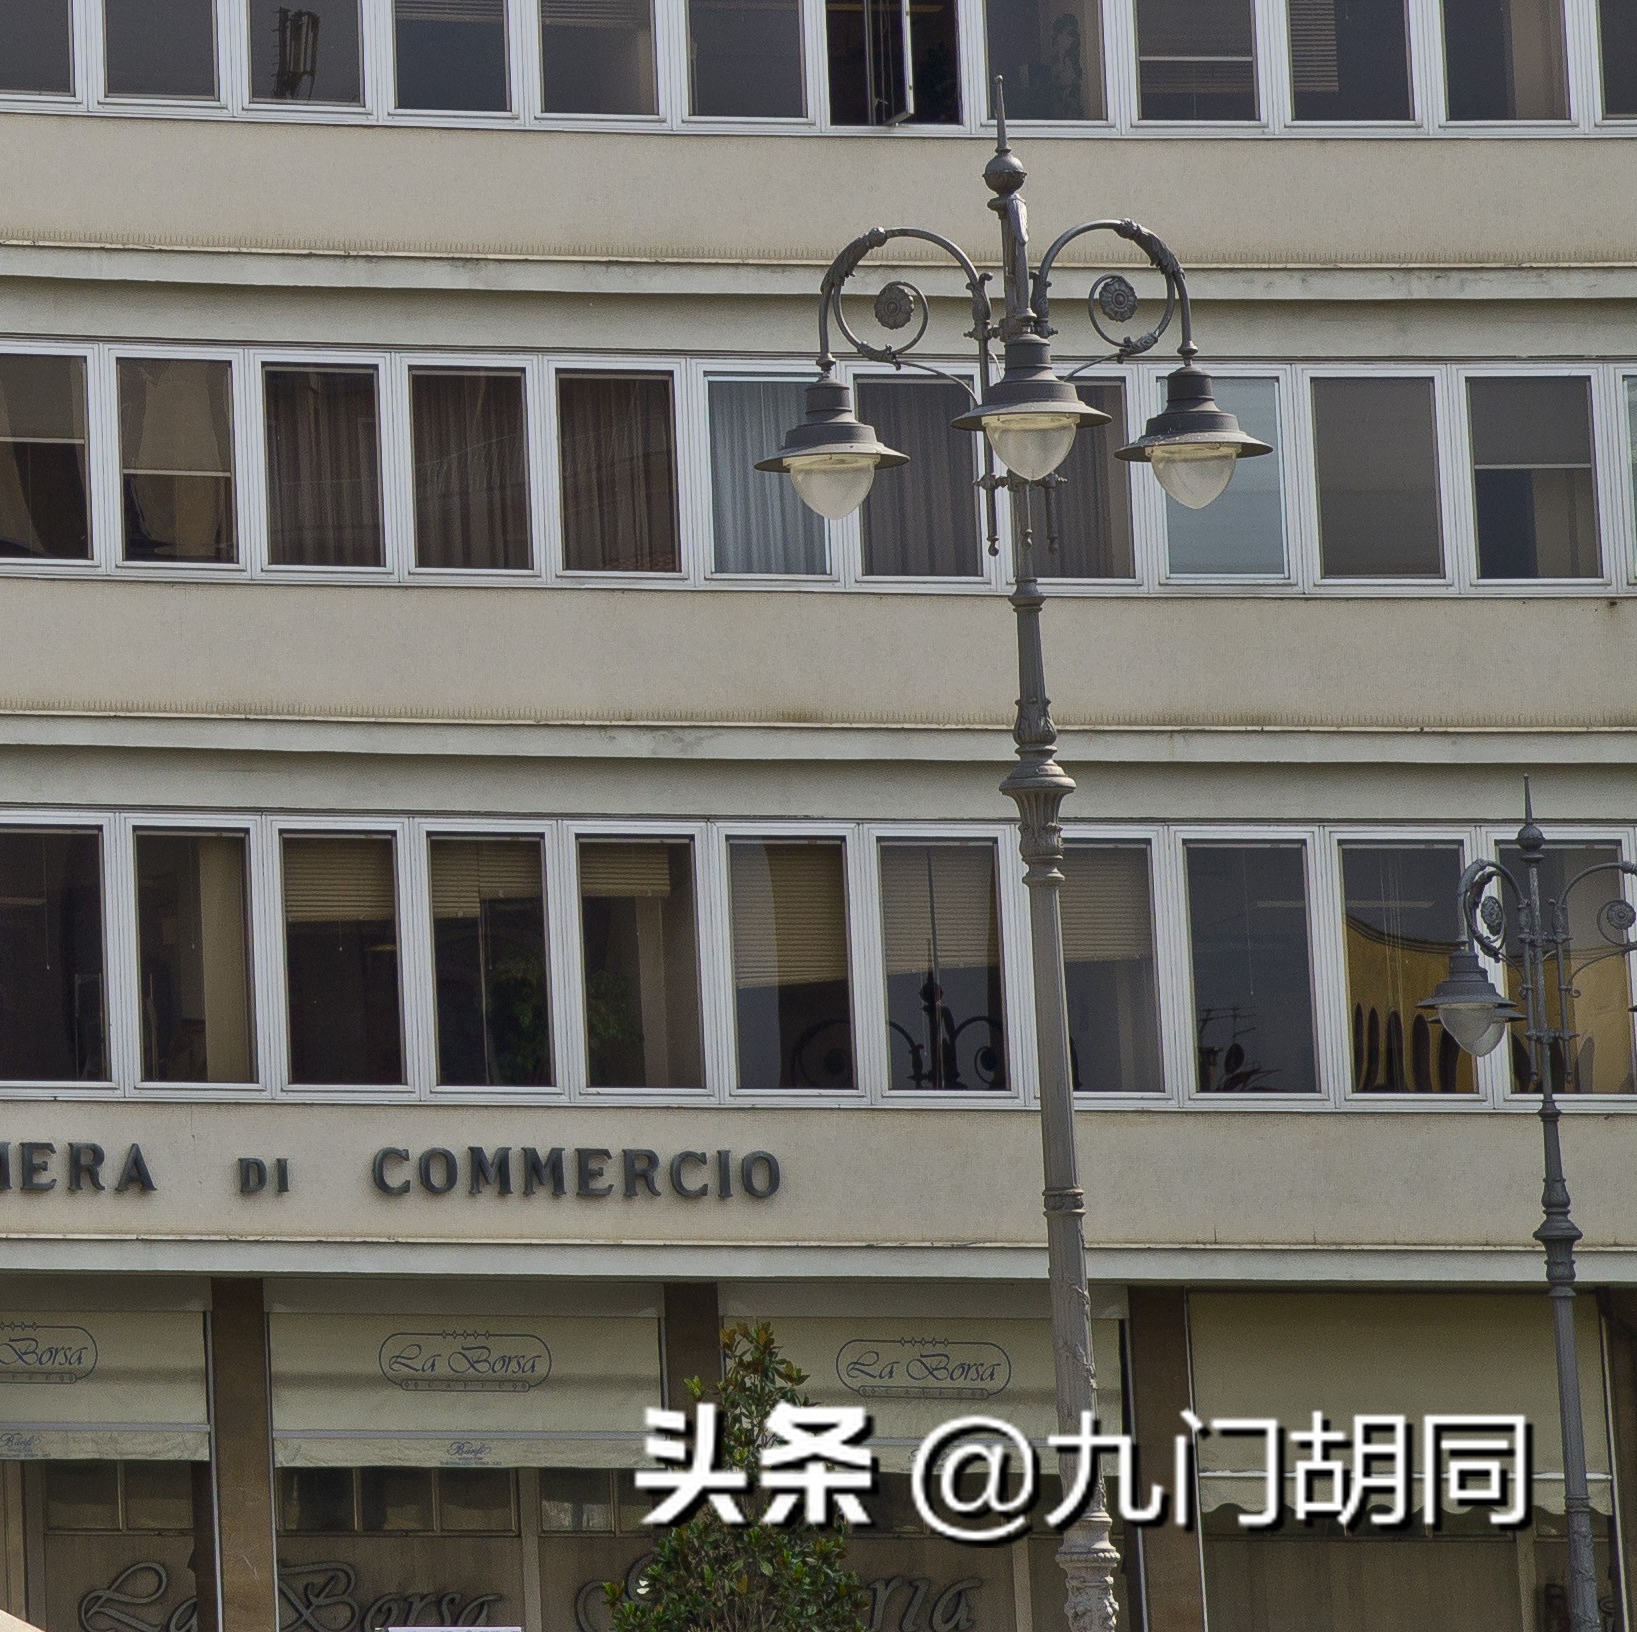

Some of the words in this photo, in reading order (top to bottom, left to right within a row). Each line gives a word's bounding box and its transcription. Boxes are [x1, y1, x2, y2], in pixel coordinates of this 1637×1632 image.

[237, 1157, 290, 1197] DI
[371, 1146, 782, 1202] COMMERCIO
[389, 1343, 442, 1372] La
[447, 1345, 543, 1374] Borsa
[845, 1350, 901, 1380] La
[905, 1352, 1002, 1382] Borsa
